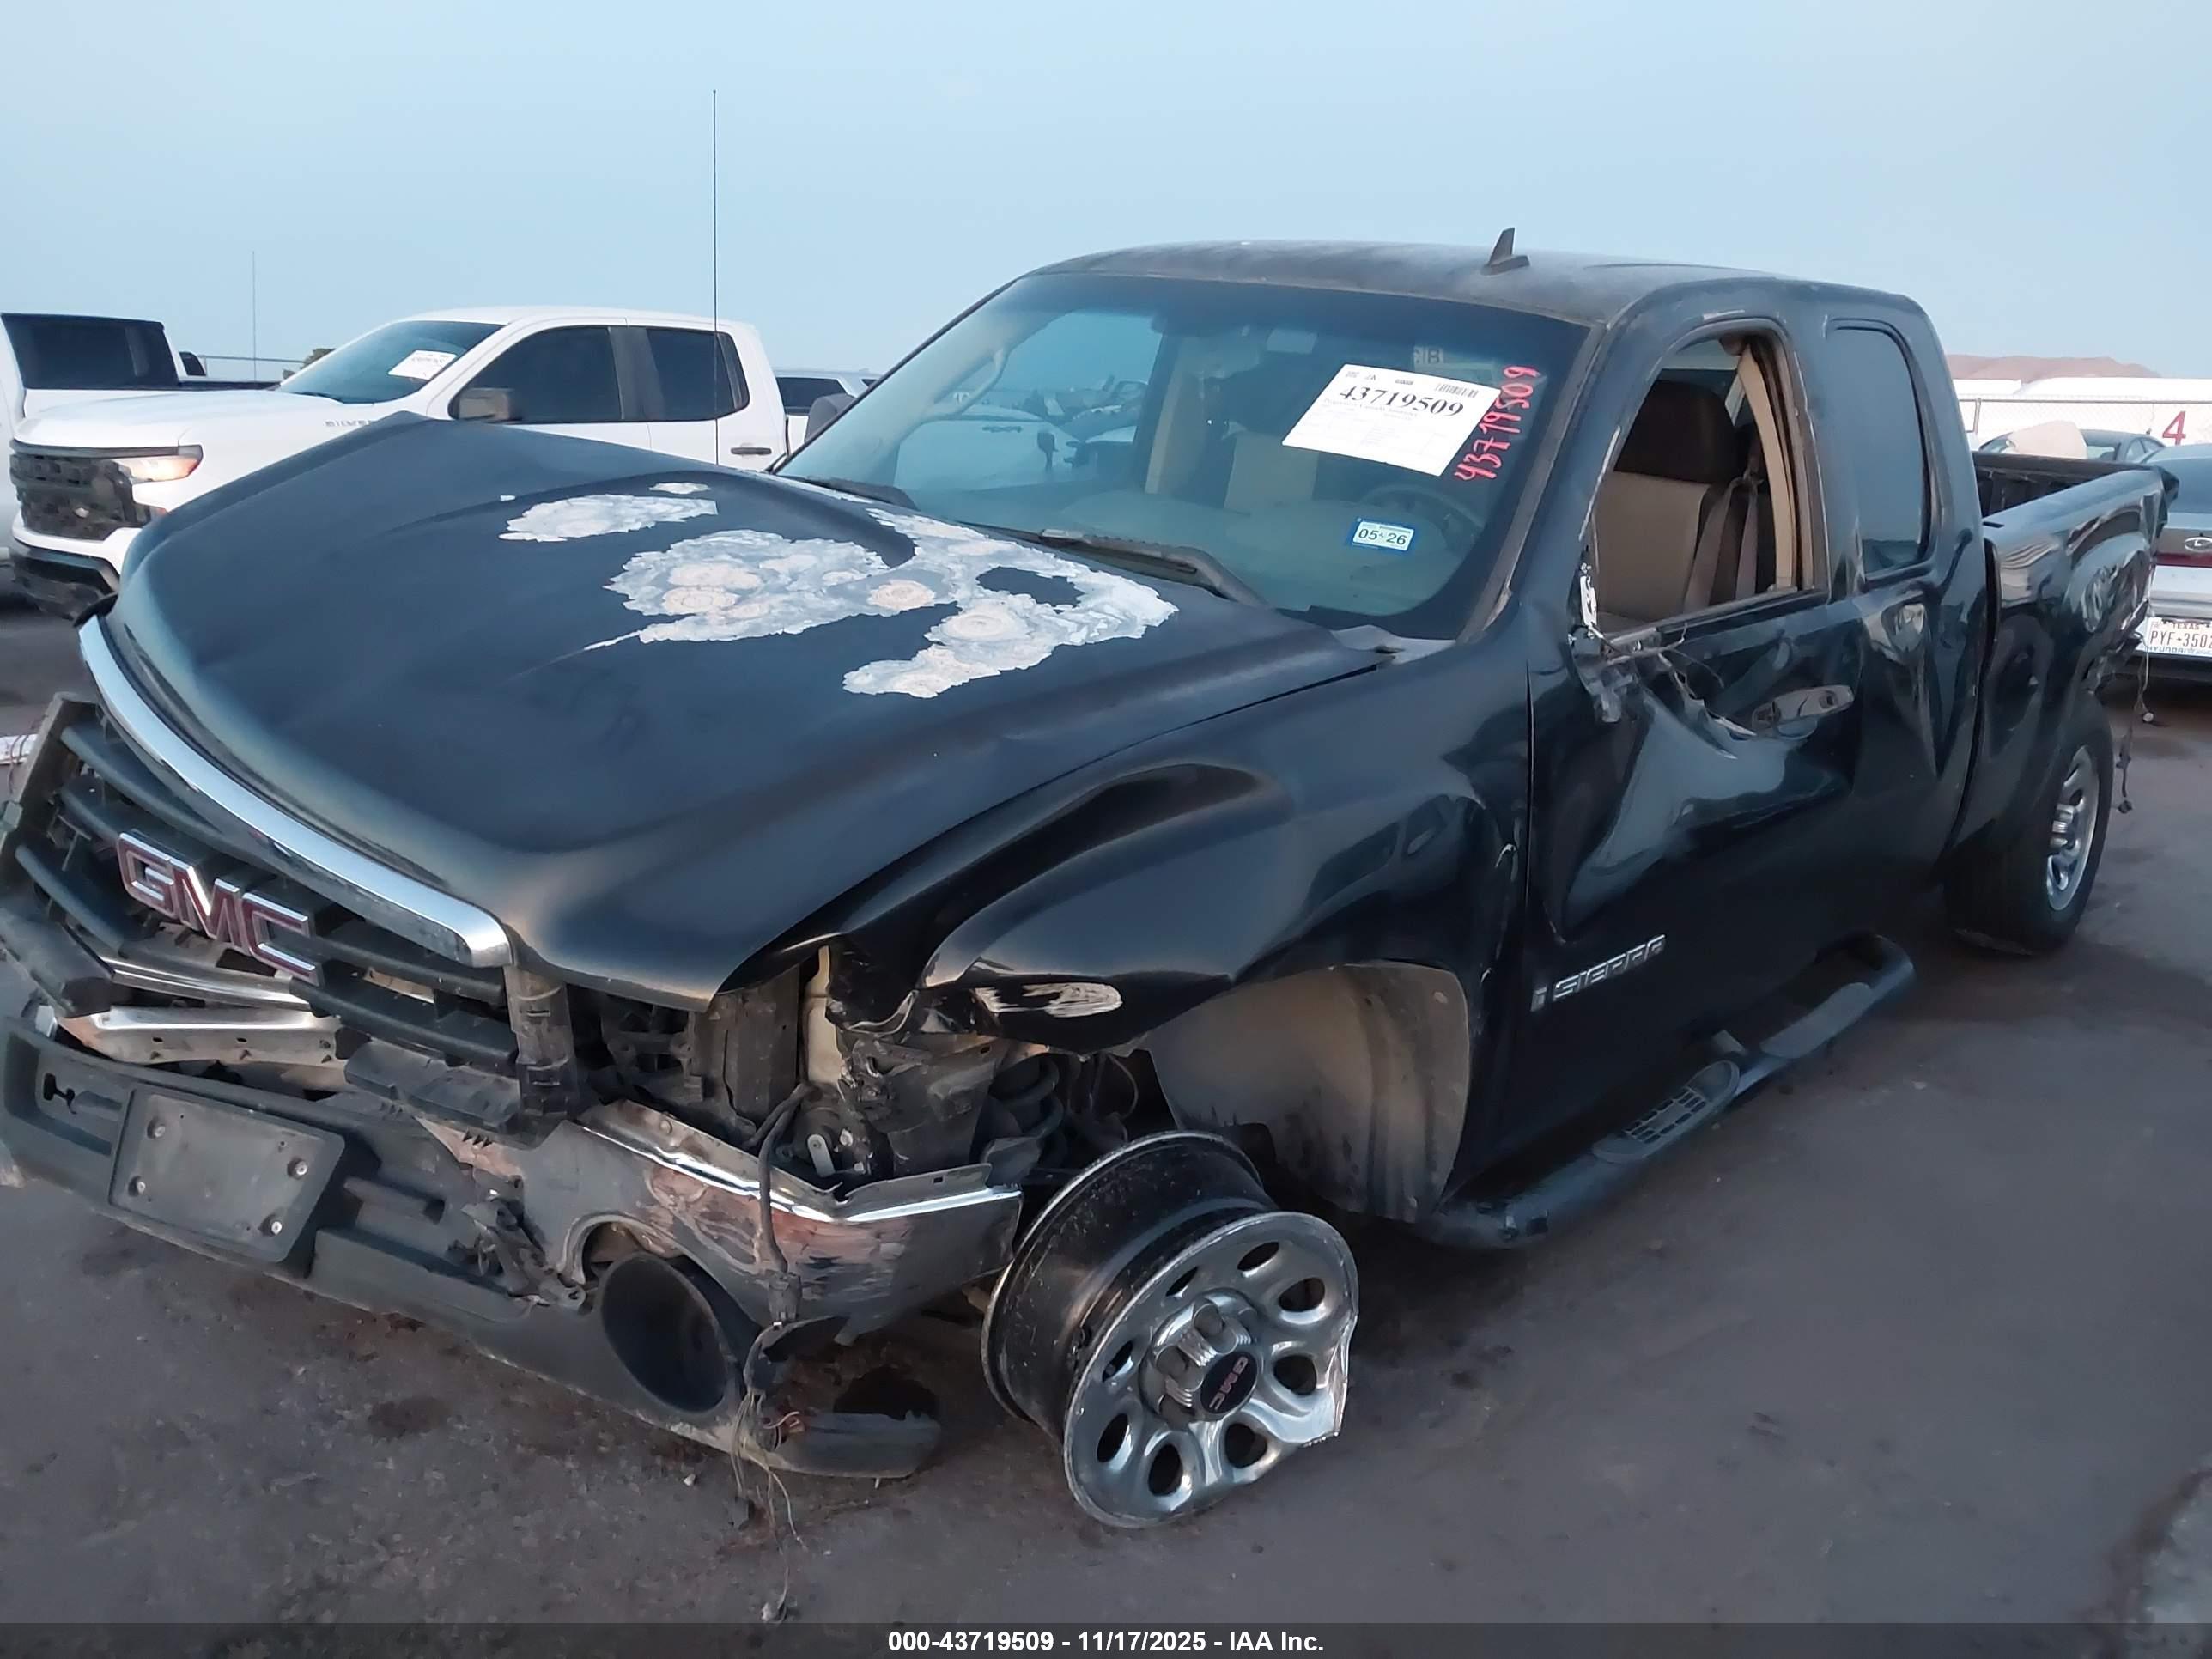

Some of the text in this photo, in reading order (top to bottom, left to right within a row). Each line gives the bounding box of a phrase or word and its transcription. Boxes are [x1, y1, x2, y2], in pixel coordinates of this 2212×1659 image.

[1339, 386, 1464, 416] 43719509
[1454, 365, 1540, 481] 43719509
[2162, 410, 2186, 445] 4
[1358, 528, 1379, 540] 05
[1386, 532, 1407, 545] 26
[117, 832, 320, 987] GMC
[1553, 934, 1666, 1001] SIERRA
[1209, 1356, 1249, 1410] GMC
